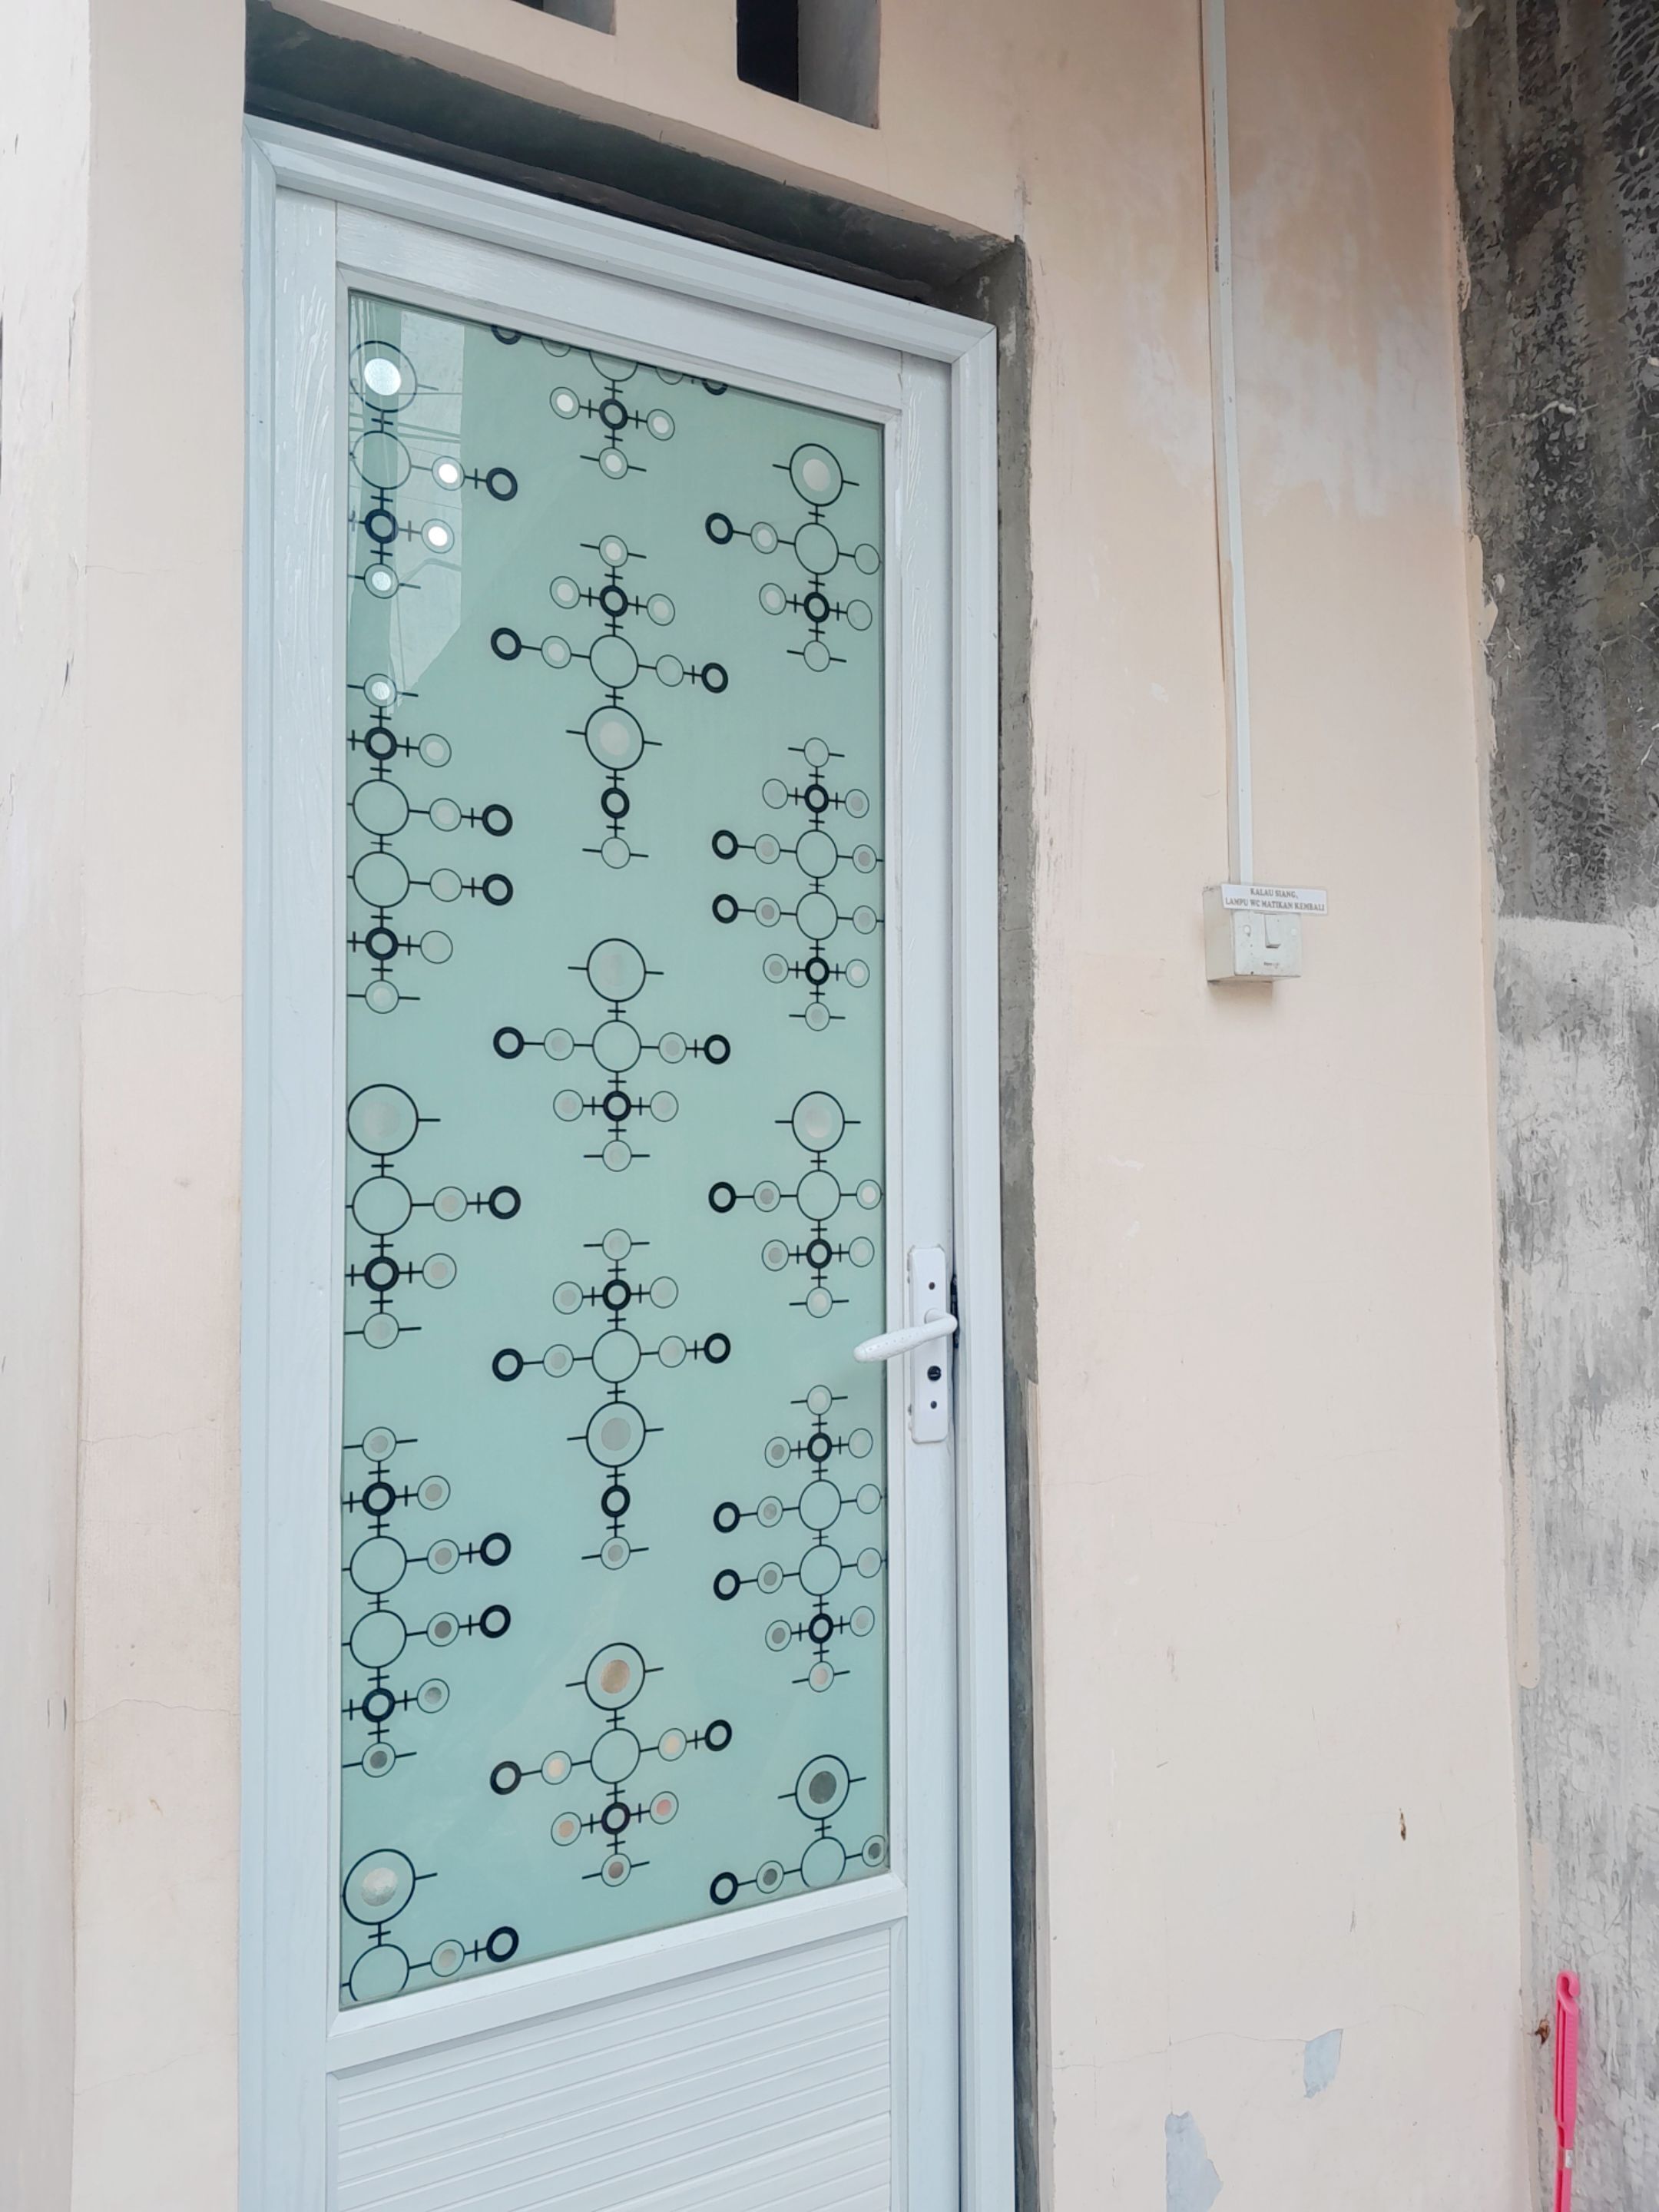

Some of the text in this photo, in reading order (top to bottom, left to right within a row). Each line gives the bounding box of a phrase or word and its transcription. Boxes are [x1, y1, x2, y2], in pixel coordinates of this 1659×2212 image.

[1250, 888, 1298, 899] KALAU SIANG,
[1225, 897, 1249, 906] LAMPU
[1262, 901, 1293, 909] MATIKAN
